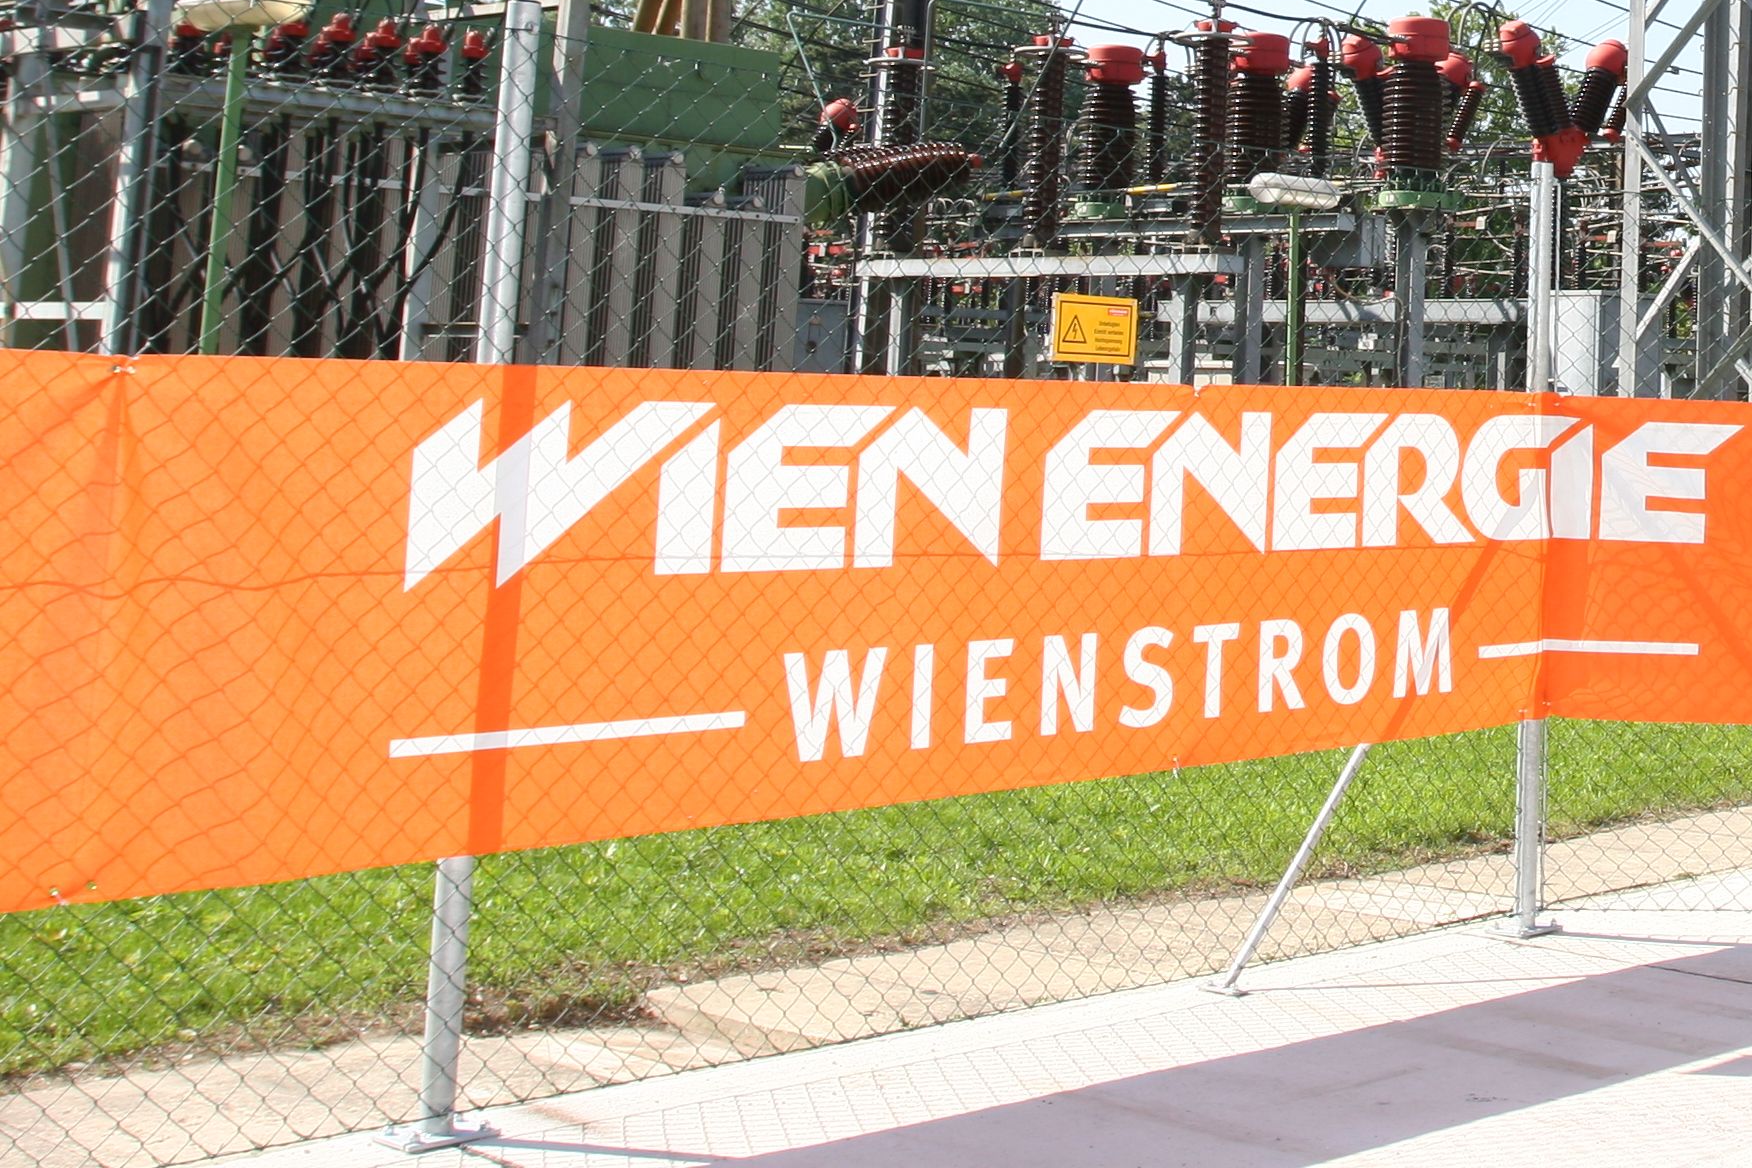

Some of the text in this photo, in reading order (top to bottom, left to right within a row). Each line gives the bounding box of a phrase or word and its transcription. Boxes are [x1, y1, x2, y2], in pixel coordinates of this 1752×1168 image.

[404, 399, 1743, 592] WIEN ENERGIE
[784, 608, 1451, 761] WIENSTROM
